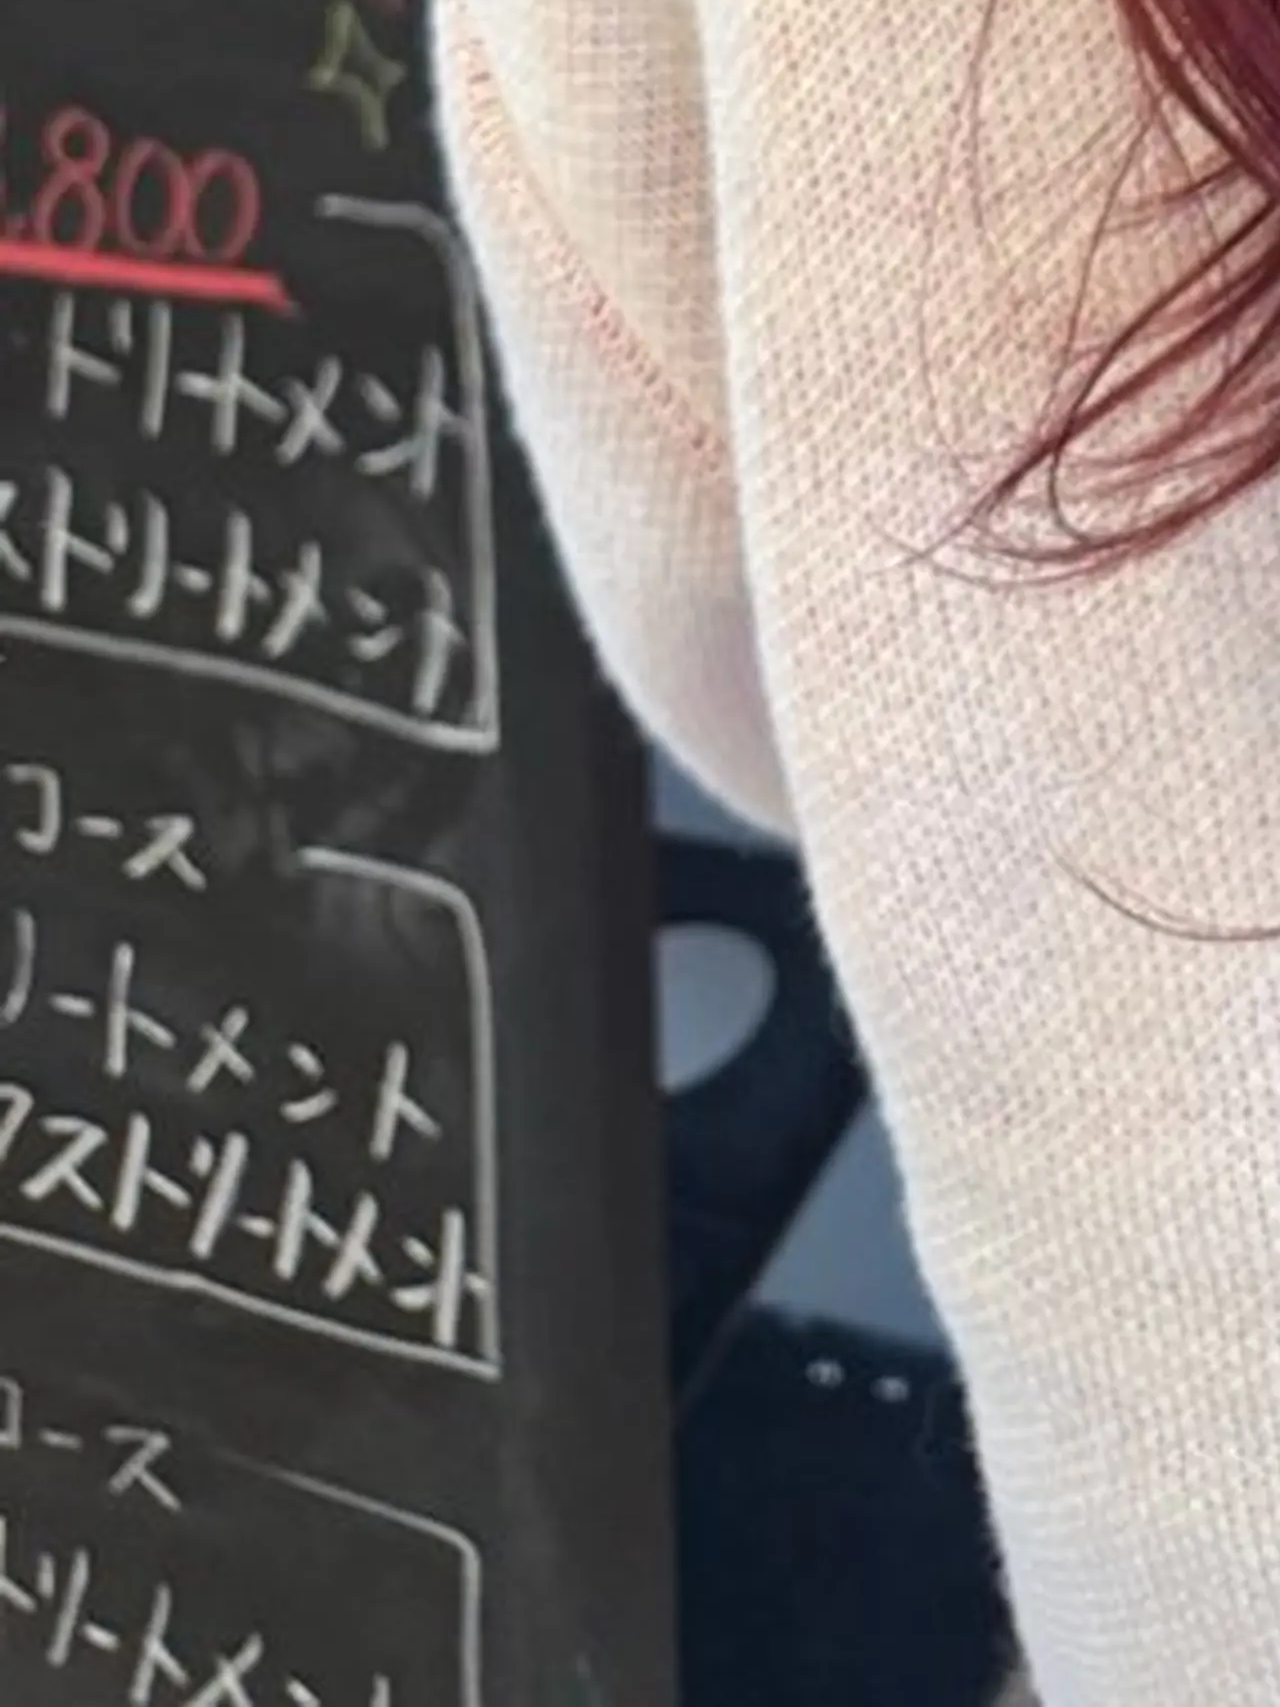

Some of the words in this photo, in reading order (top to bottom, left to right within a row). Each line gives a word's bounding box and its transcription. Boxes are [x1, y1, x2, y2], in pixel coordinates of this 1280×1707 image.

[0, 105, 260, 263] ,800
[6, 763, 208, 891] コース
